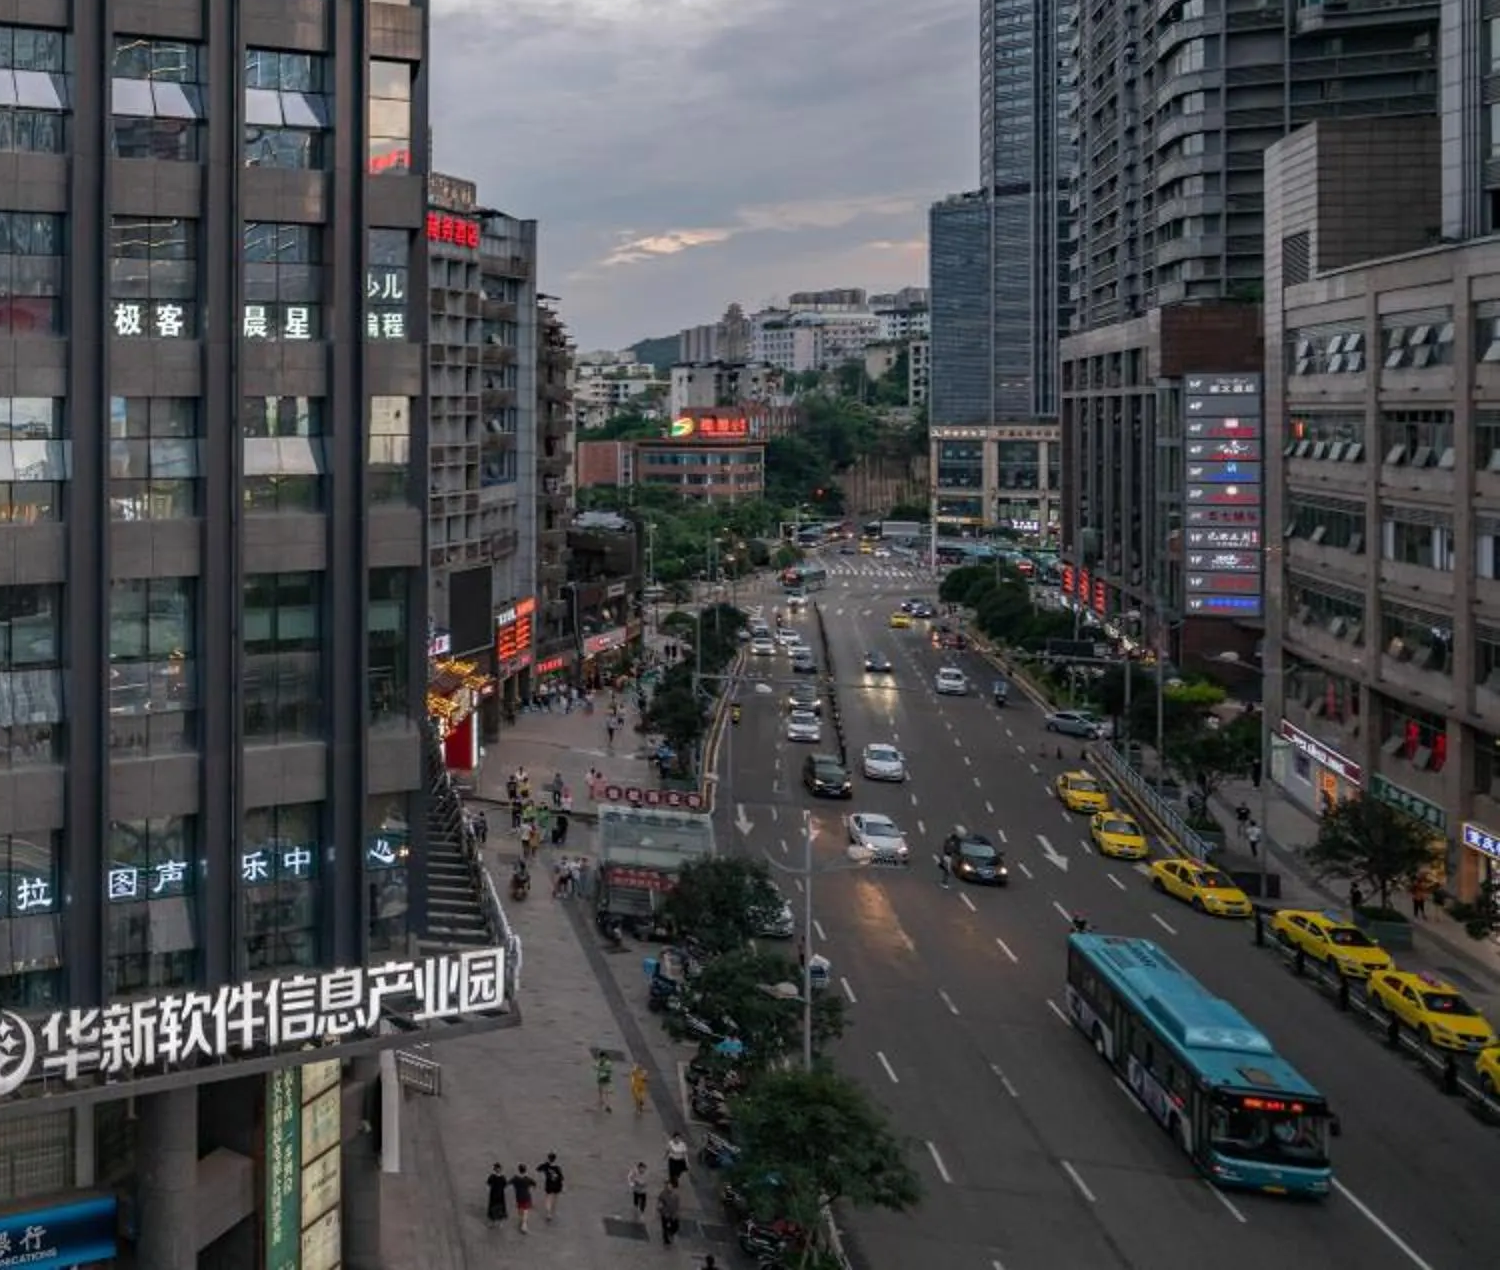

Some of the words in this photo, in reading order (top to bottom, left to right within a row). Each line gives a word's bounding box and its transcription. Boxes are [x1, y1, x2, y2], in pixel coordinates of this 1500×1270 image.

[41, 947, 505, 1082] 华新软件信息产业园
